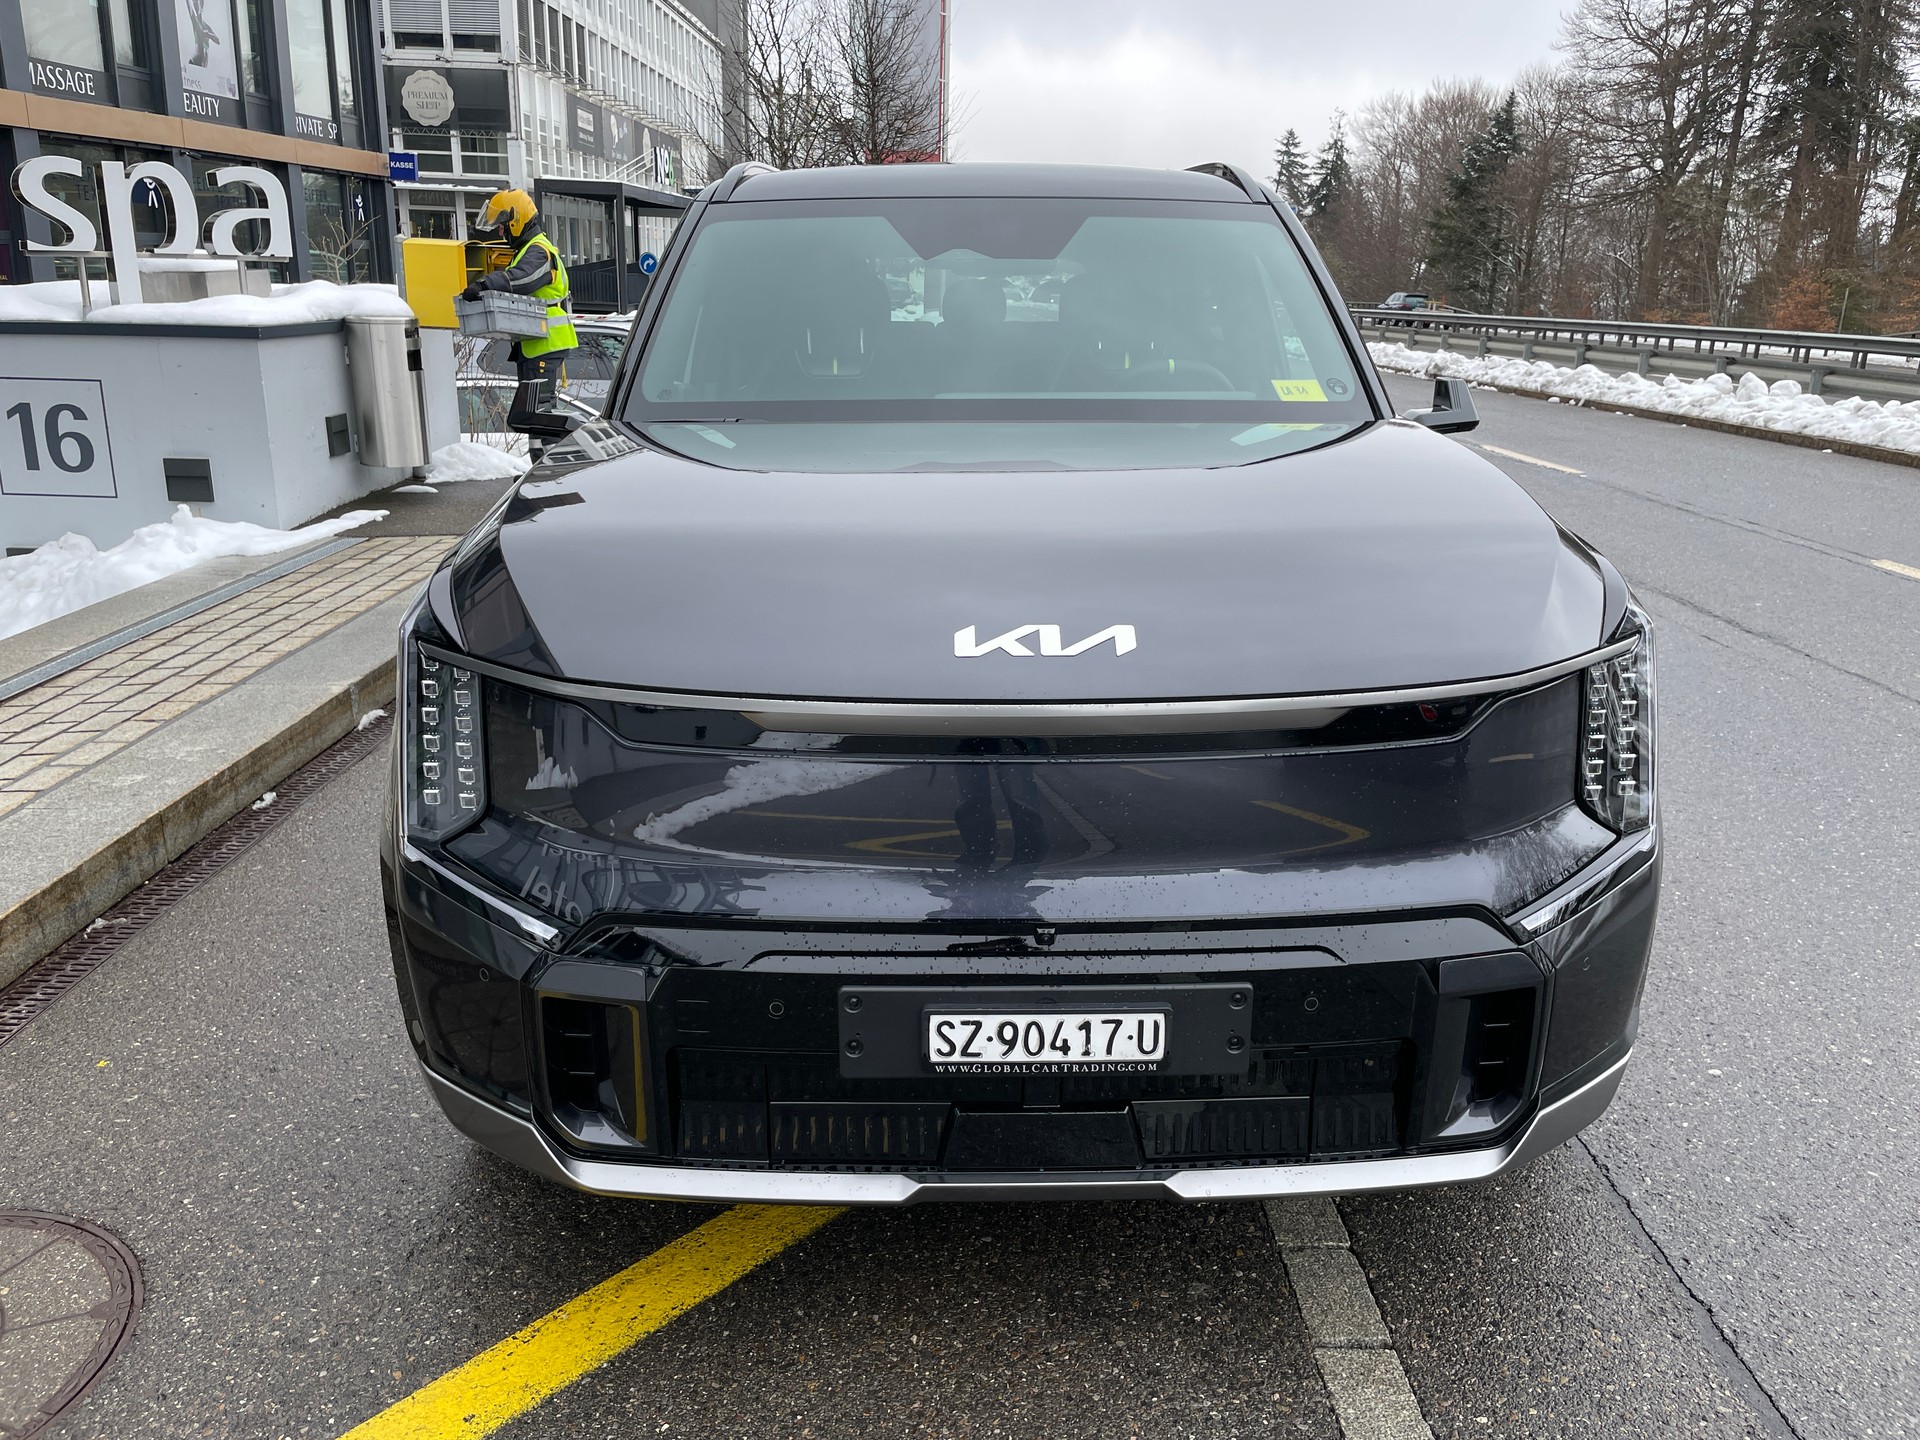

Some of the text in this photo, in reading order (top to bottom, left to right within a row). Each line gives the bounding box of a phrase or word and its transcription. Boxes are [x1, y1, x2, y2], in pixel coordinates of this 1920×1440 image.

[407, 91, 448, 100] PREMIUM
[390, 161, 414, 169] KASSE
[11, 155, 294, 304] spa
[6, 402, 95, 473] 16
